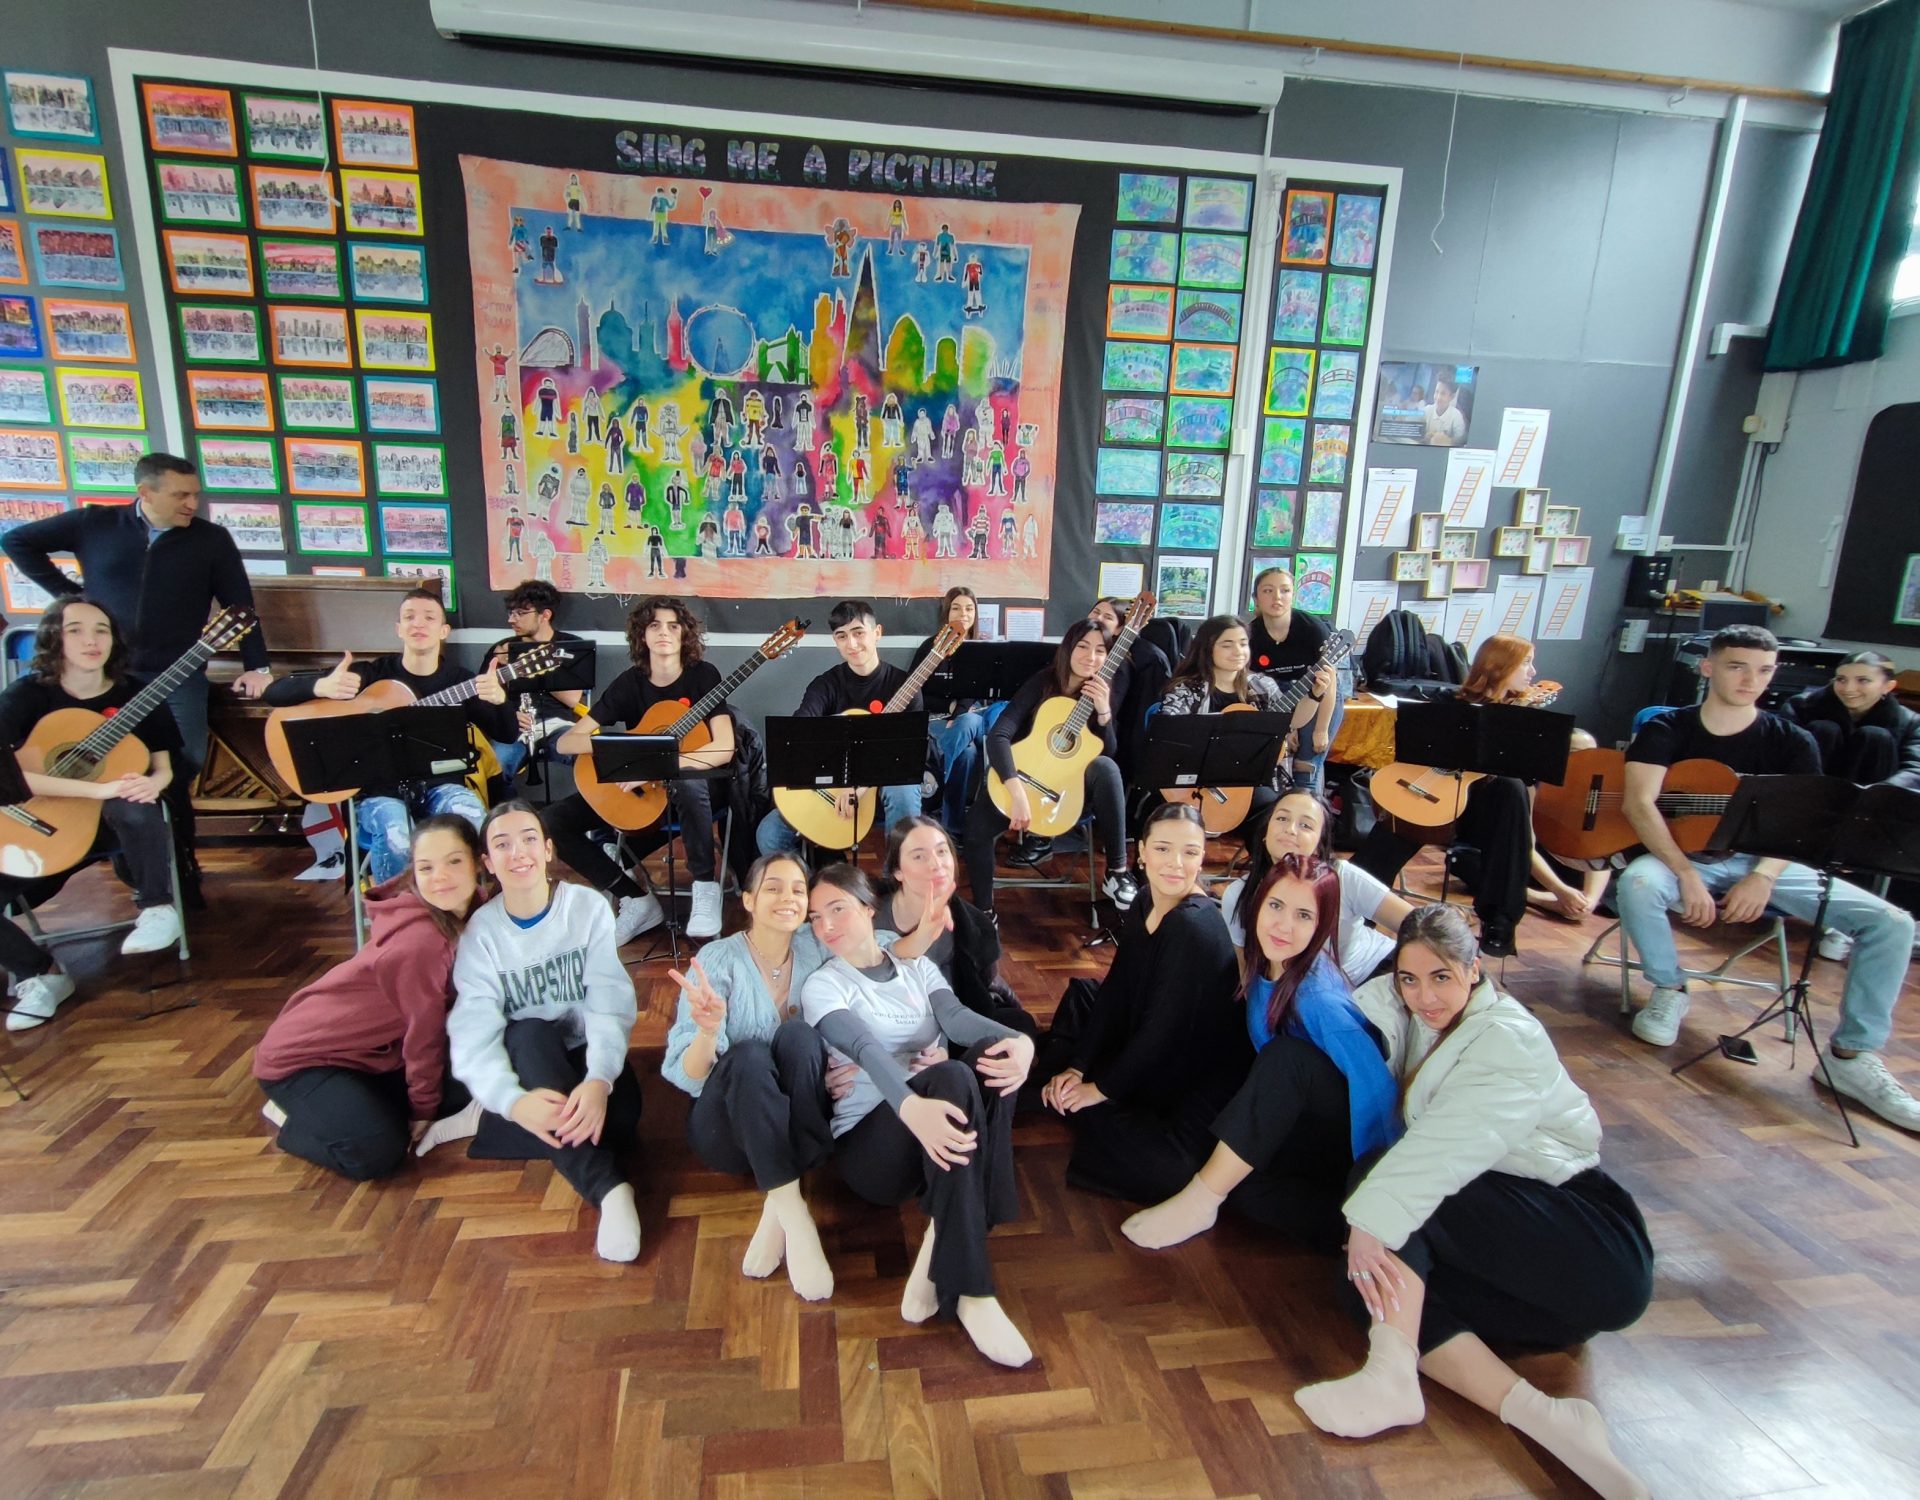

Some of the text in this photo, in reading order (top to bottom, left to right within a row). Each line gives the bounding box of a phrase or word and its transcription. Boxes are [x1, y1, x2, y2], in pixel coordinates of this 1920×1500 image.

[615, 130, 998, 197] SING ME A PICTURE
[498, 946, 588, 1014] AMPSHIR
